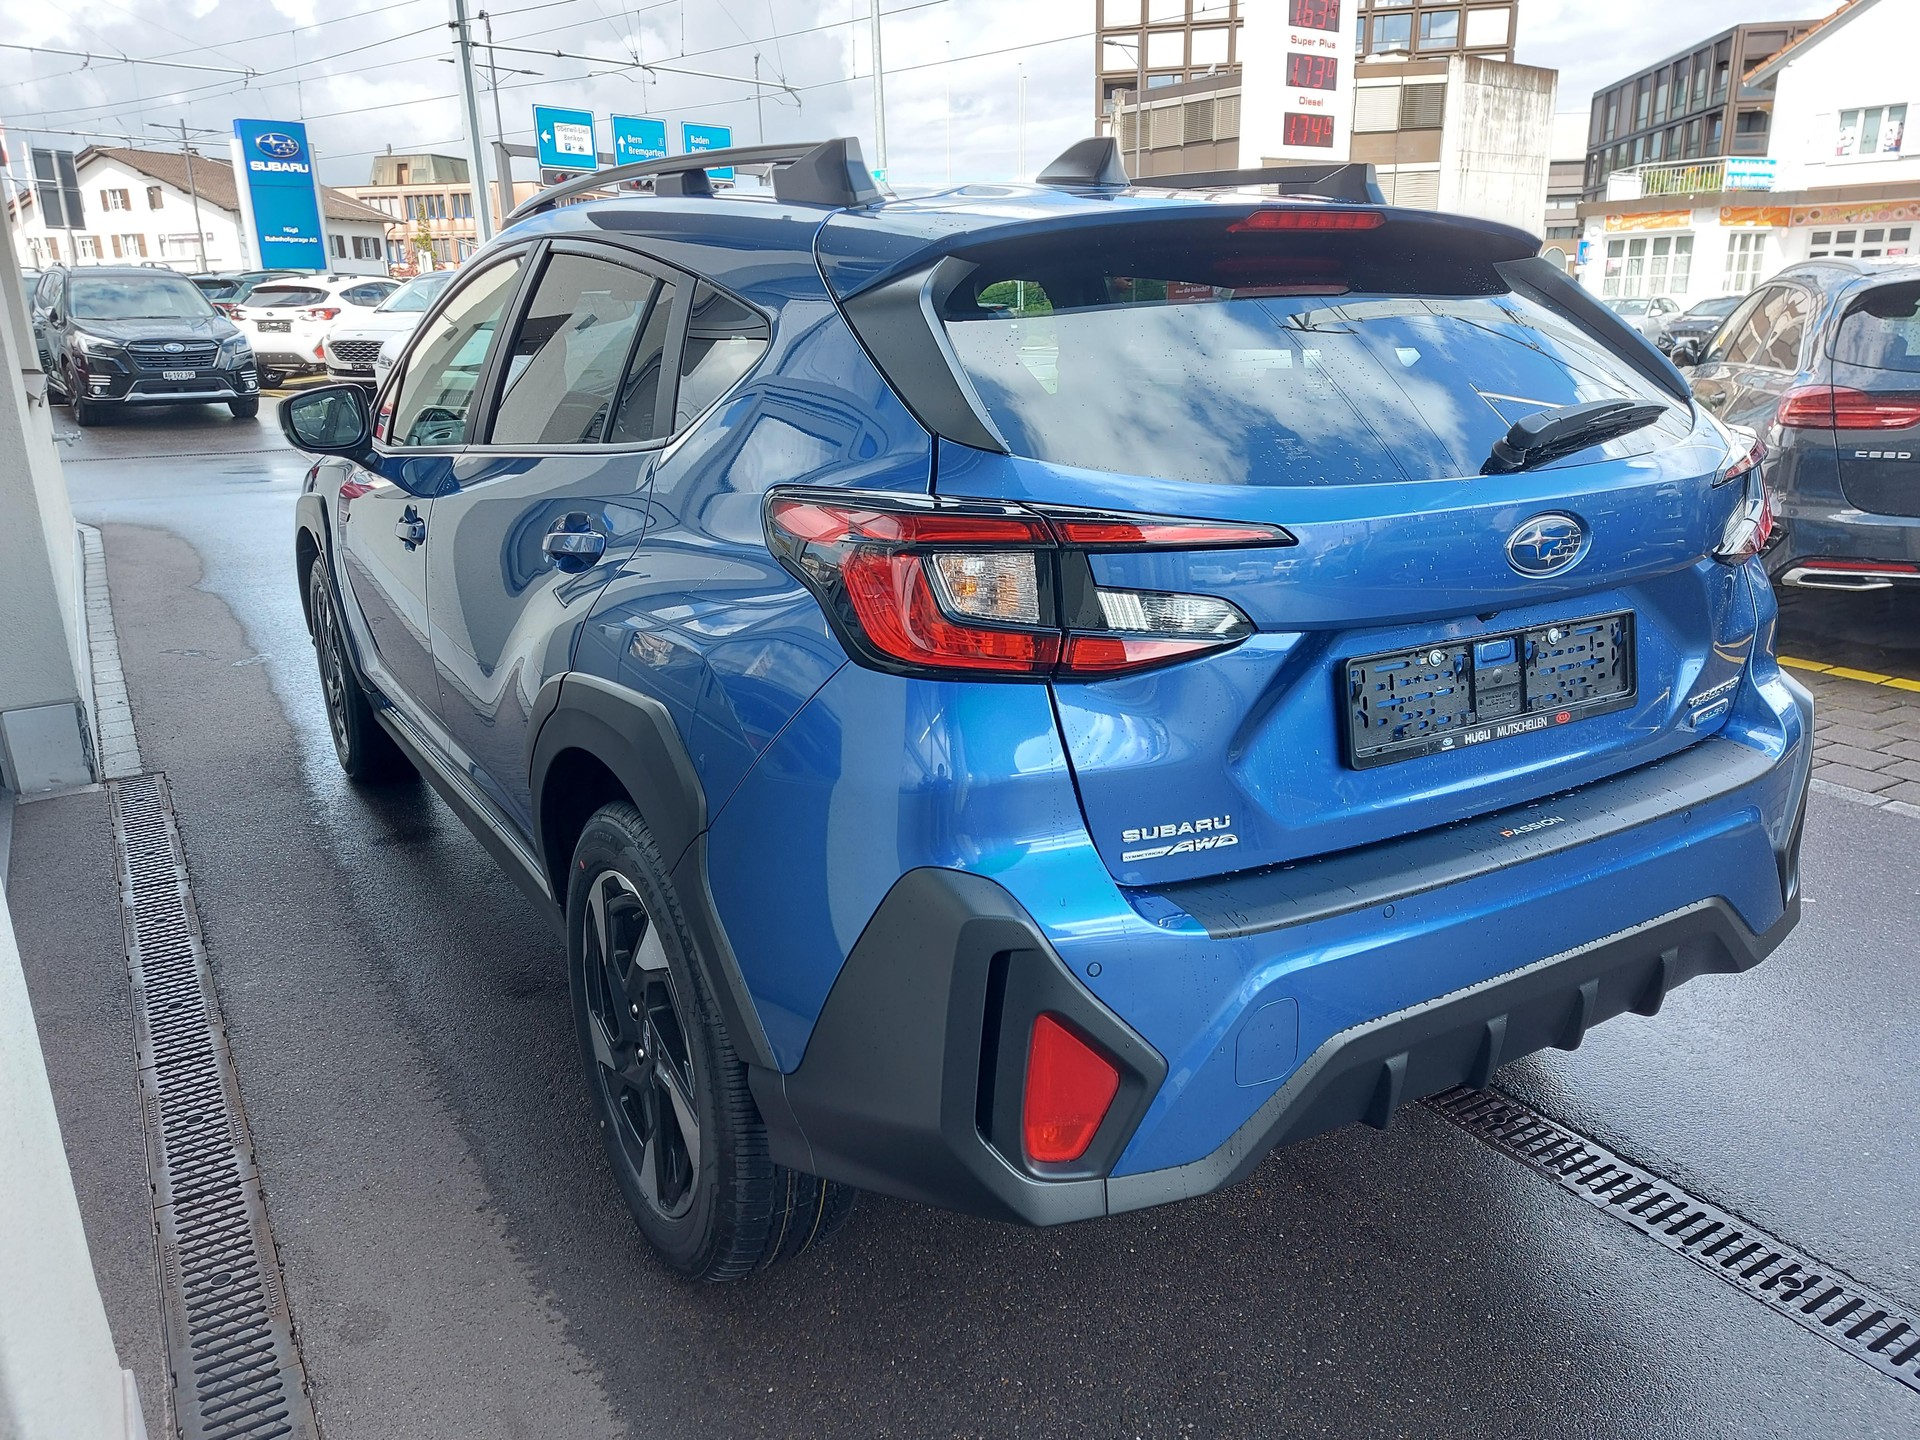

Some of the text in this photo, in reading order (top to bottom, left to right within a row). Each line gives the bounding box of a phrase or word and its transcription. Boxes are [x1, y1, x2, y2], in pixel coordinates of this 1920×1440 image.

[1290, 35, 1336, 49] Super Plus
[1298, 96, 1324, 106] Diesel
[627, 134, 643, 144] Bern
[690, 135, 710, 145] Baden
[628, 146, 665, 158] Bremgarten
[250, 161, 310, 173] SUBARU
[1497, 716, 1548, 738] MUTSCHELLEN
[1122, 814, 1231, 843] SUBARU
[1500, 815, 1565, 838] PASSION
[1166, 833, 1239, 856] AWD
